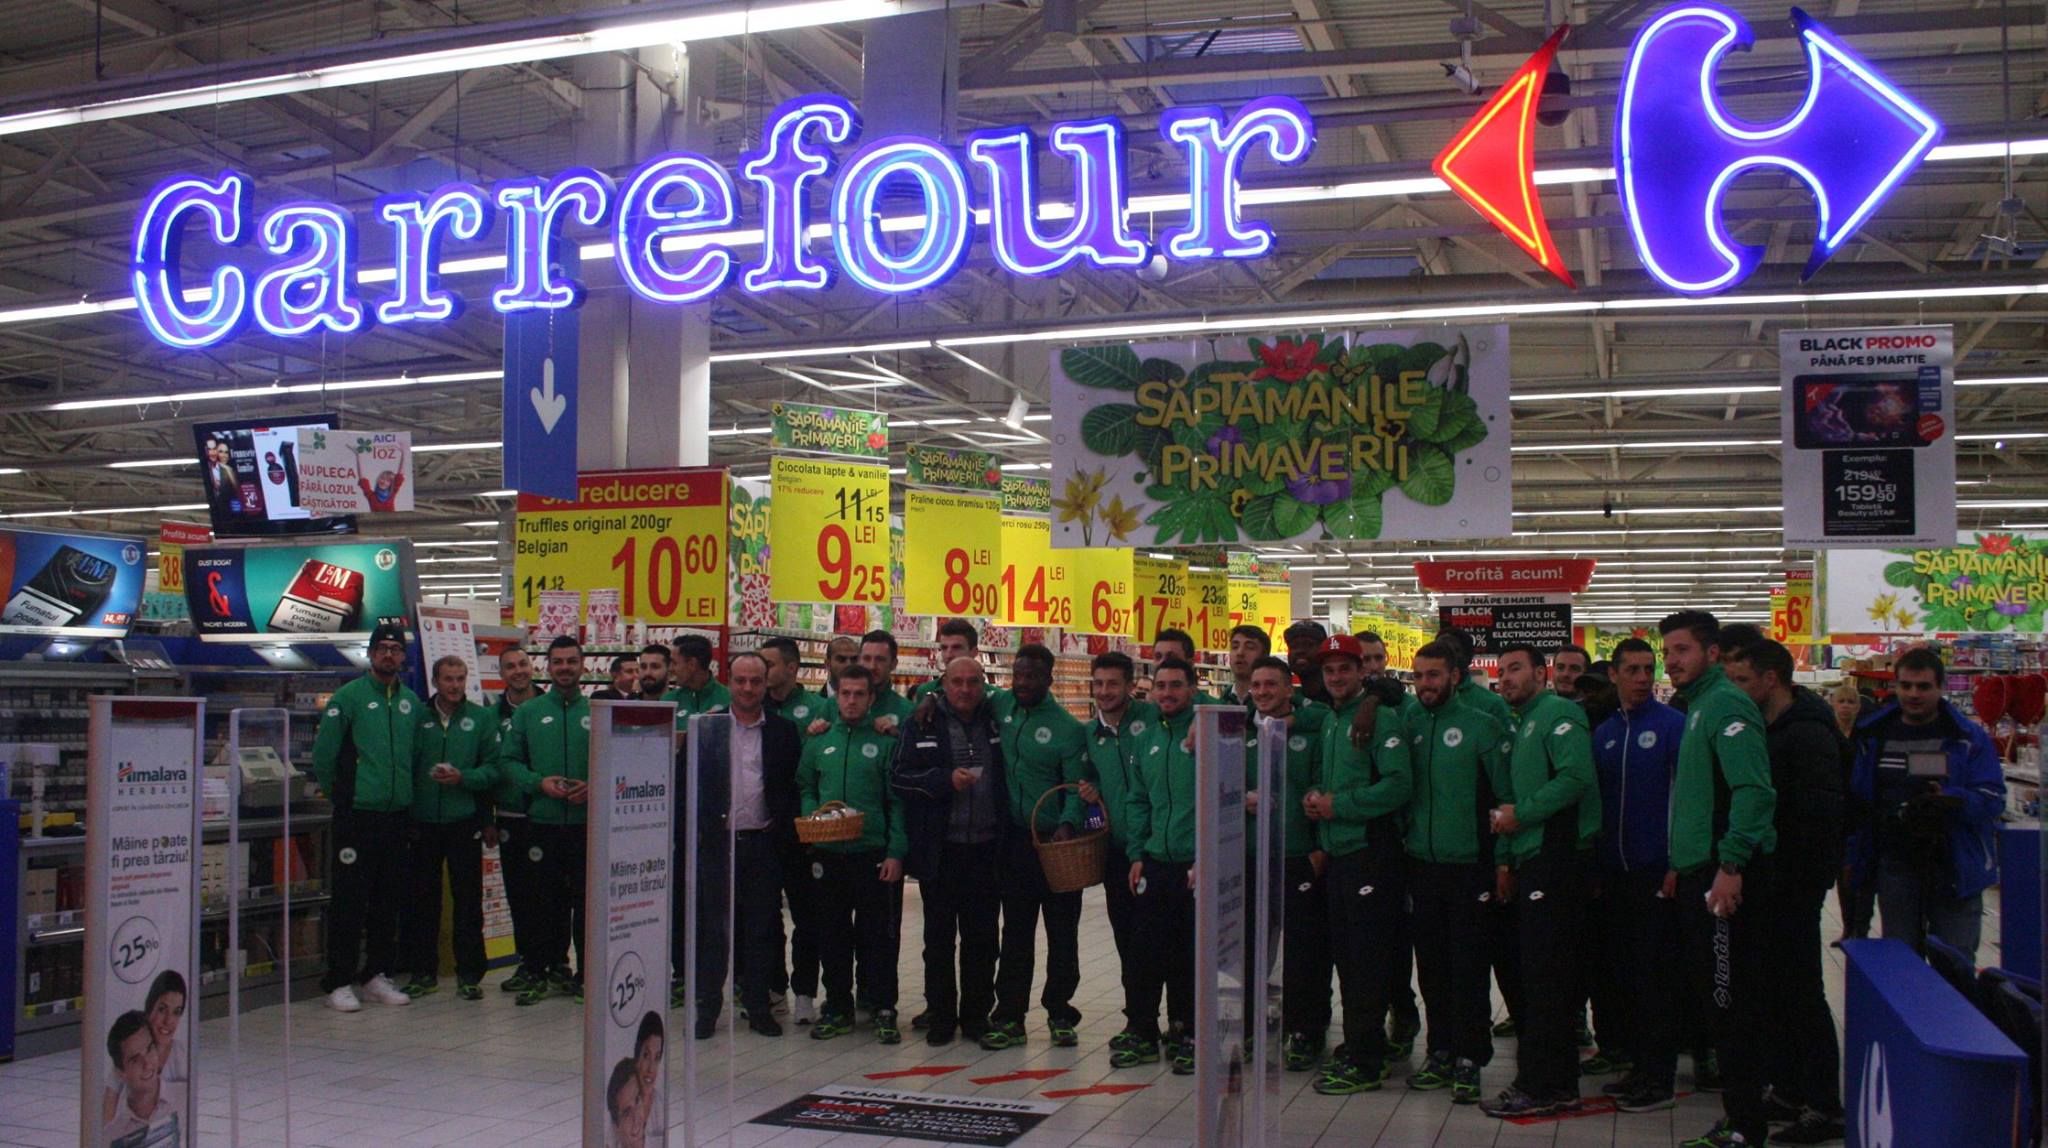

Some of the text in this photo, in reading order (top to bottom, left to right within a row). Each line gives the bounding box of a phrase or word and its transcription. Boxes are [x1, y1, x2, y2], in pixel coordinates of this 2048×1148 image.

[130, 94, 1316, 351] Carrefour
[1800, 334, 1937, 352] BLACK PROMO
[1811, 354, 1926, 367] PÂNĂ PE 9 MARTIE
[373, 433, 396, 443] AICI
[300, 464, 357, 479] NU PLECA
[777, 460, 888, 480] Ciocolata lapte & vanilie
[323, 483, 357, 495] LOZUL
[579, 480, 690, 503] reducere
[1834, 484, 1897, 502] 159 LEI 90
[834, 487, 862, 521] 11
[866, 506, 885, 523] 15
[518, 514, 672, 535] Truffles original 200gr
[1001, 521, 1015, 530] erci
[517, 539, 568, 557] Belgian
[685, 534, 718, 575] 60
[162, 555, 180, 587] 38
[817, 523, 886, 601] 9 LEI 25
[314, 563, 353, 590] L&M
[611, 535, 682, 617] 10
[943, 547, 998, 616] 8 LEI 90
[1445, 566, 1564, 582] Profită acum!
[1001, 564, 1071, 625] 14 LEI 26
[1158, 574, 1176, 595] 20
[1201, 585, 1217, 604] 23
[19, 599, 61, 622] Fumatul
[686, 598, 716, 618] LEI
[1091, 580, 1131, 633] 6 LEI 97
[1241, 593, 1249, 610] 9
[1511, 596, 1545, 605] MARTIE
[289, 604, 331, 623] Fumatul
[290, 613, 323, 628] poate
[1133, 595, 1182, 642] 17 LEI
[1212, 606, 1224, 617] LEI
[1451, 606, 1493, 616] BLACK
[1502, 610, 1557, 620] LA SUTE DE
[1787, 595, 1803, 633] 6
[1263, 616, 1277, 639] 7
[1774, 610, 1788, 643] 5
[1212, 628, 1228, 650] 99
[117, 761, 187, 783] Himalaya
[118, 785, 187, 796] HERBALS
[615, 775, 666, 800] Himalaya
[615, 802, 666, 816] HERBALS
[152, 834, 188, 853] poate
[111, 854, 120, 869] fi
[122, 855, 151, 871] prea
[639, 857, 666, 876] poate
[618, 881, 639, 899] prea
[113, 934, 159, 969] -25%
[1713, 918, 1730, 987] lotto
[950, 1099, 1035, 1111] MARTIE
